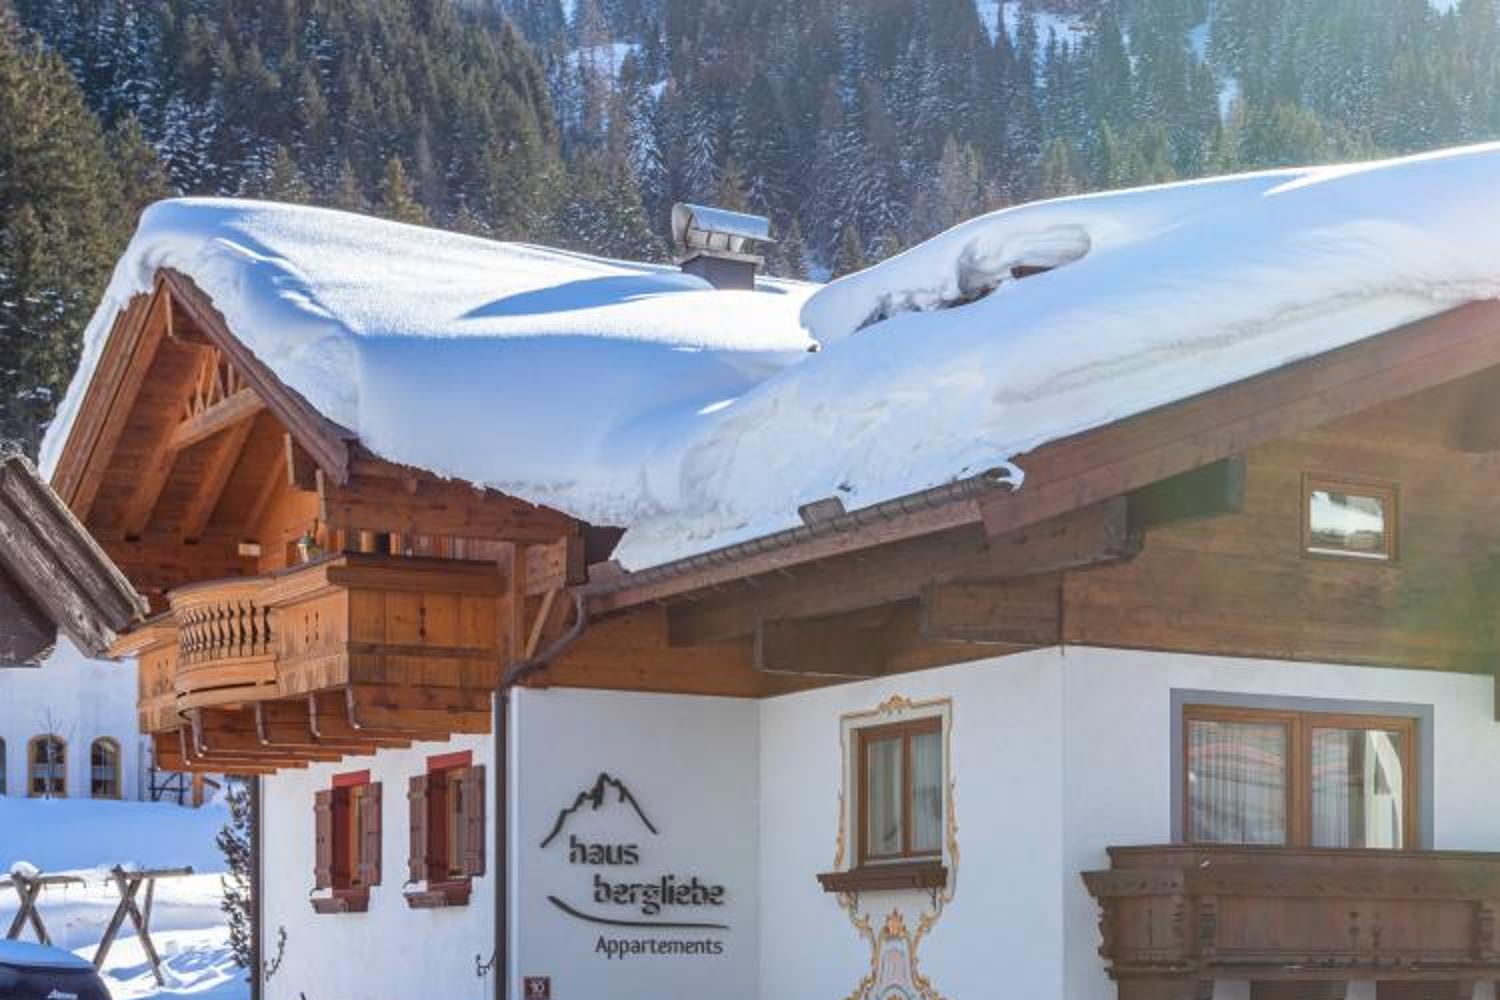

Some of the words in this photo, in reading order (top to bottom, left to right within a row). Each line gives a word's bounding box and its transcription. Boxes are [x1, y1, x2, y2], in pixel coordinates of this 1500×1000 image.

[569, 835, 639, 865] haus
[594, 874, 725, 915] bergliebe
[595, 935, 724, 960] Appartements
